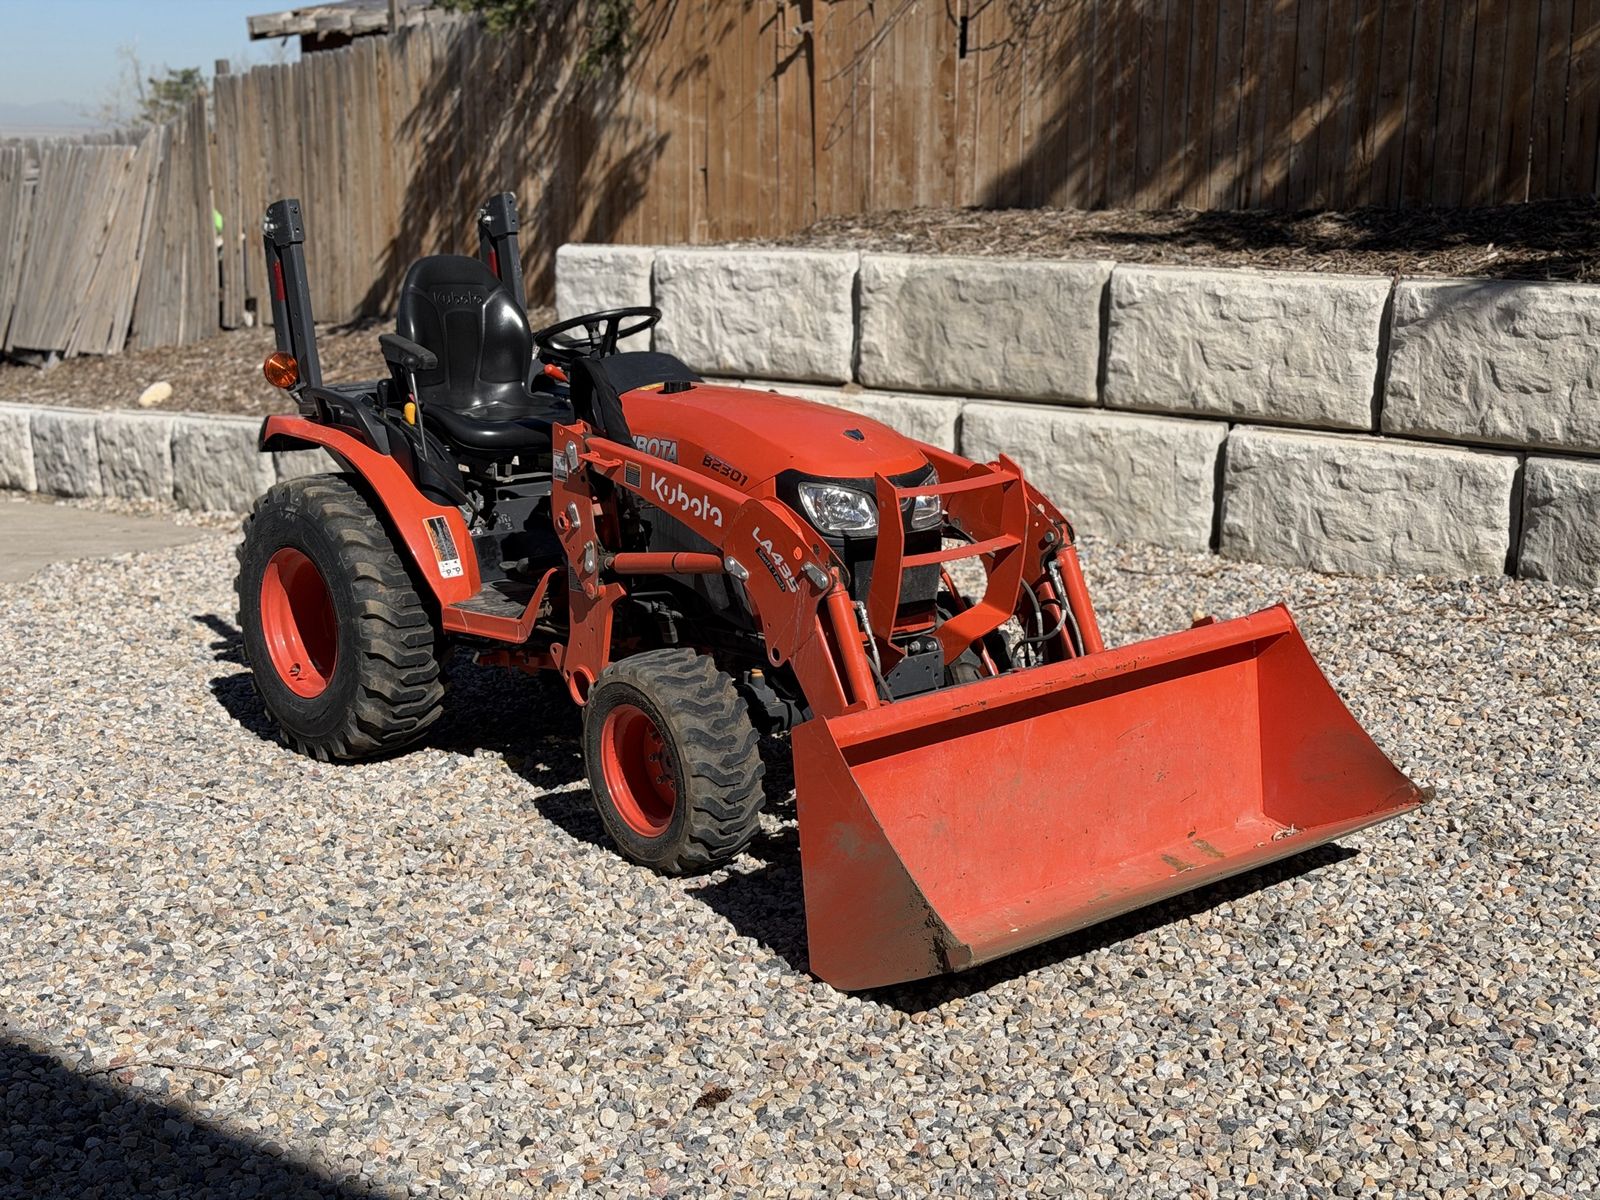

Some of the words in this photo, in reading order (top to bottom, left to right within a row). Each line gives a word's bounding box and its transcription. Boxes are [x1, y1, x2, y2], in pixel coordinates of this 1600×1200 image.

[432, 289, 482, 305] Kubota
[632, 435, 678, 463] BOTA
[702, 453, 748, 486] B2301
[651, 472, 723, 527] Kubota
[752, 526, 800, 593] LA435
